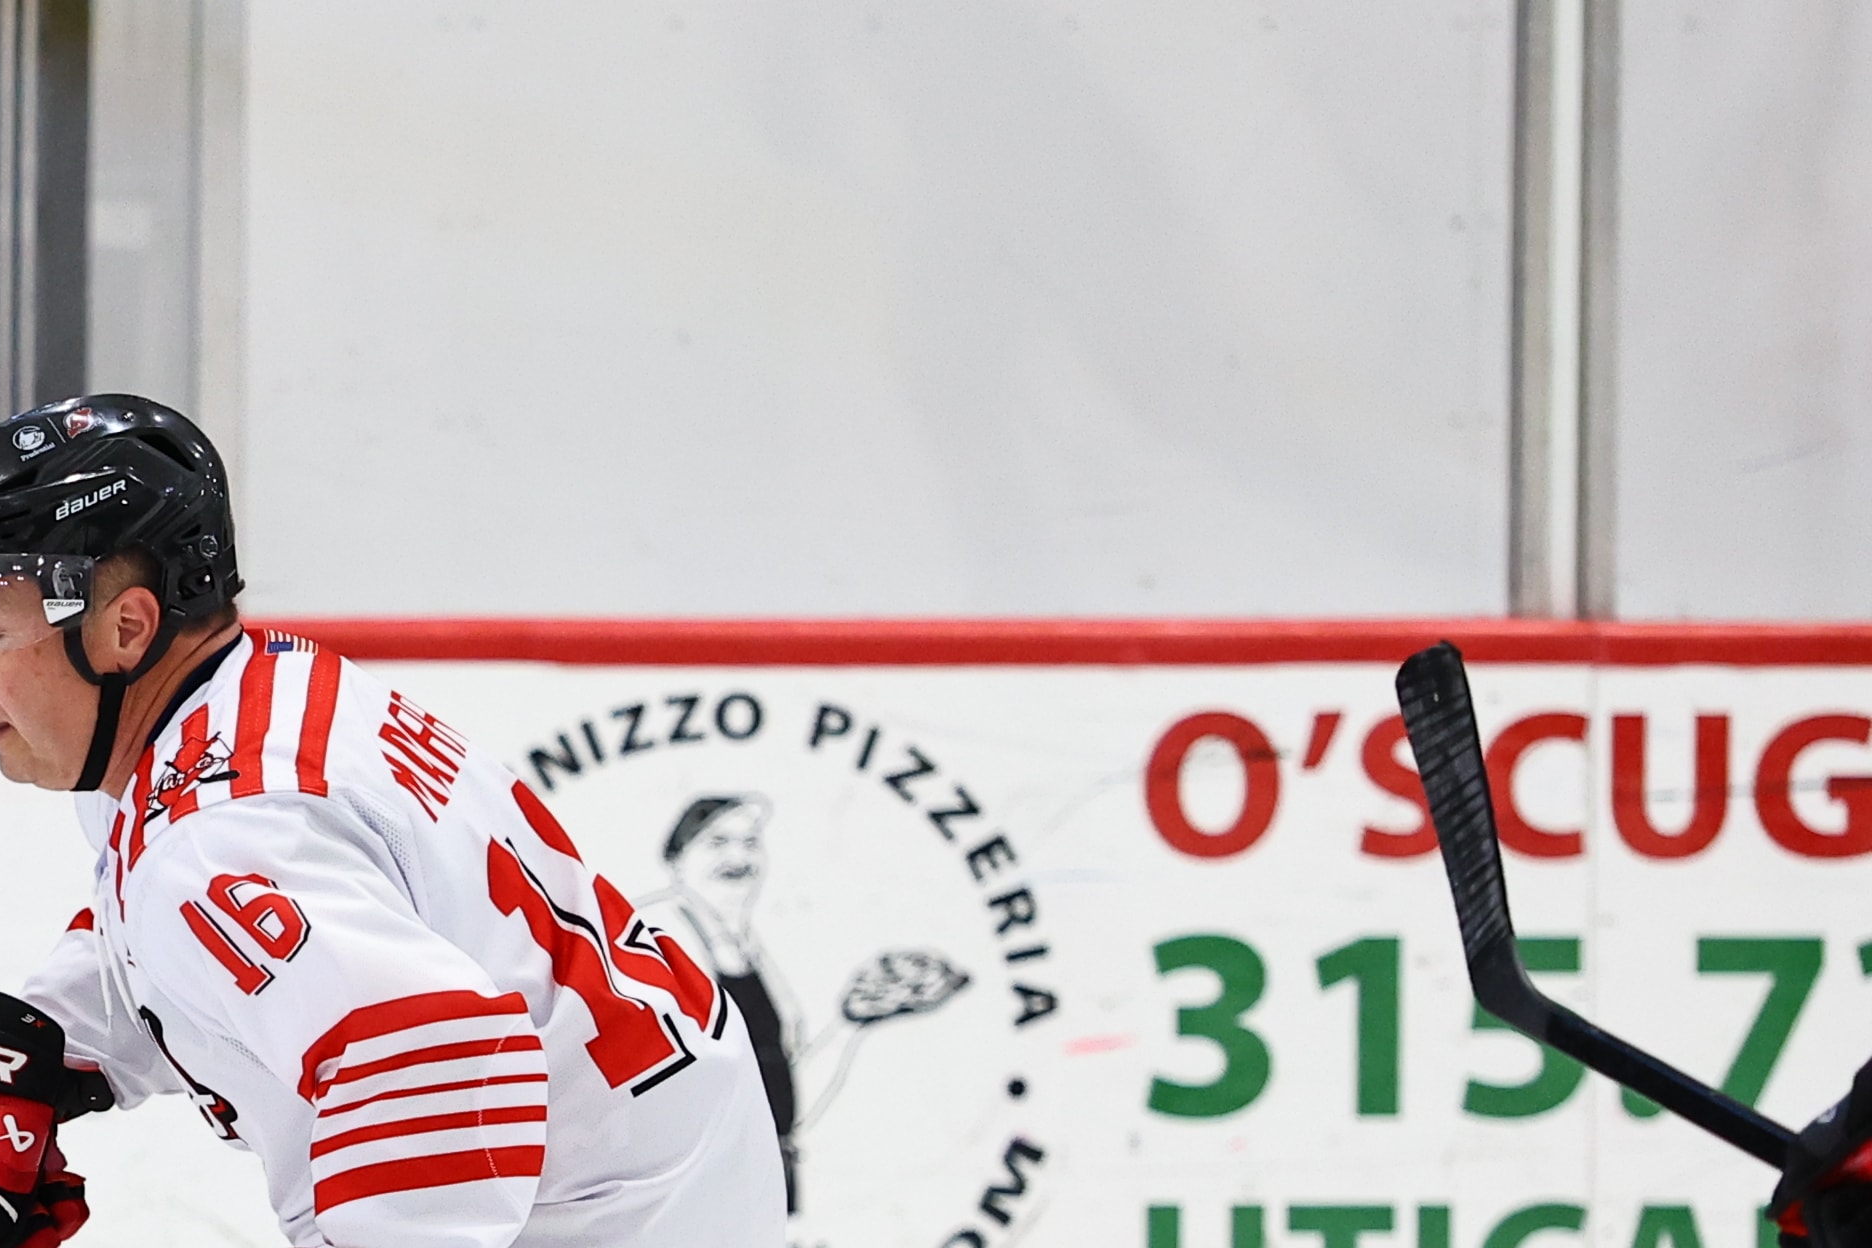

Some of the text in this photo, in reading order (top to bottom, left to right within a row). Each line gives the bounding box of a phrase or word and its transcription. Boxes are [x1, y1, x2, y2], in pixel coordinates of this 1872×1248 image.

[55, 479, 127, 521] BAUER
[527, 692, 1059, 1028] NIZZO PIZZERIA
[1144, 710, 1872, 862] O'SCUG
[179, 872, 312, 997] 16
[1147, 932, 1872, 1120] 315.7
